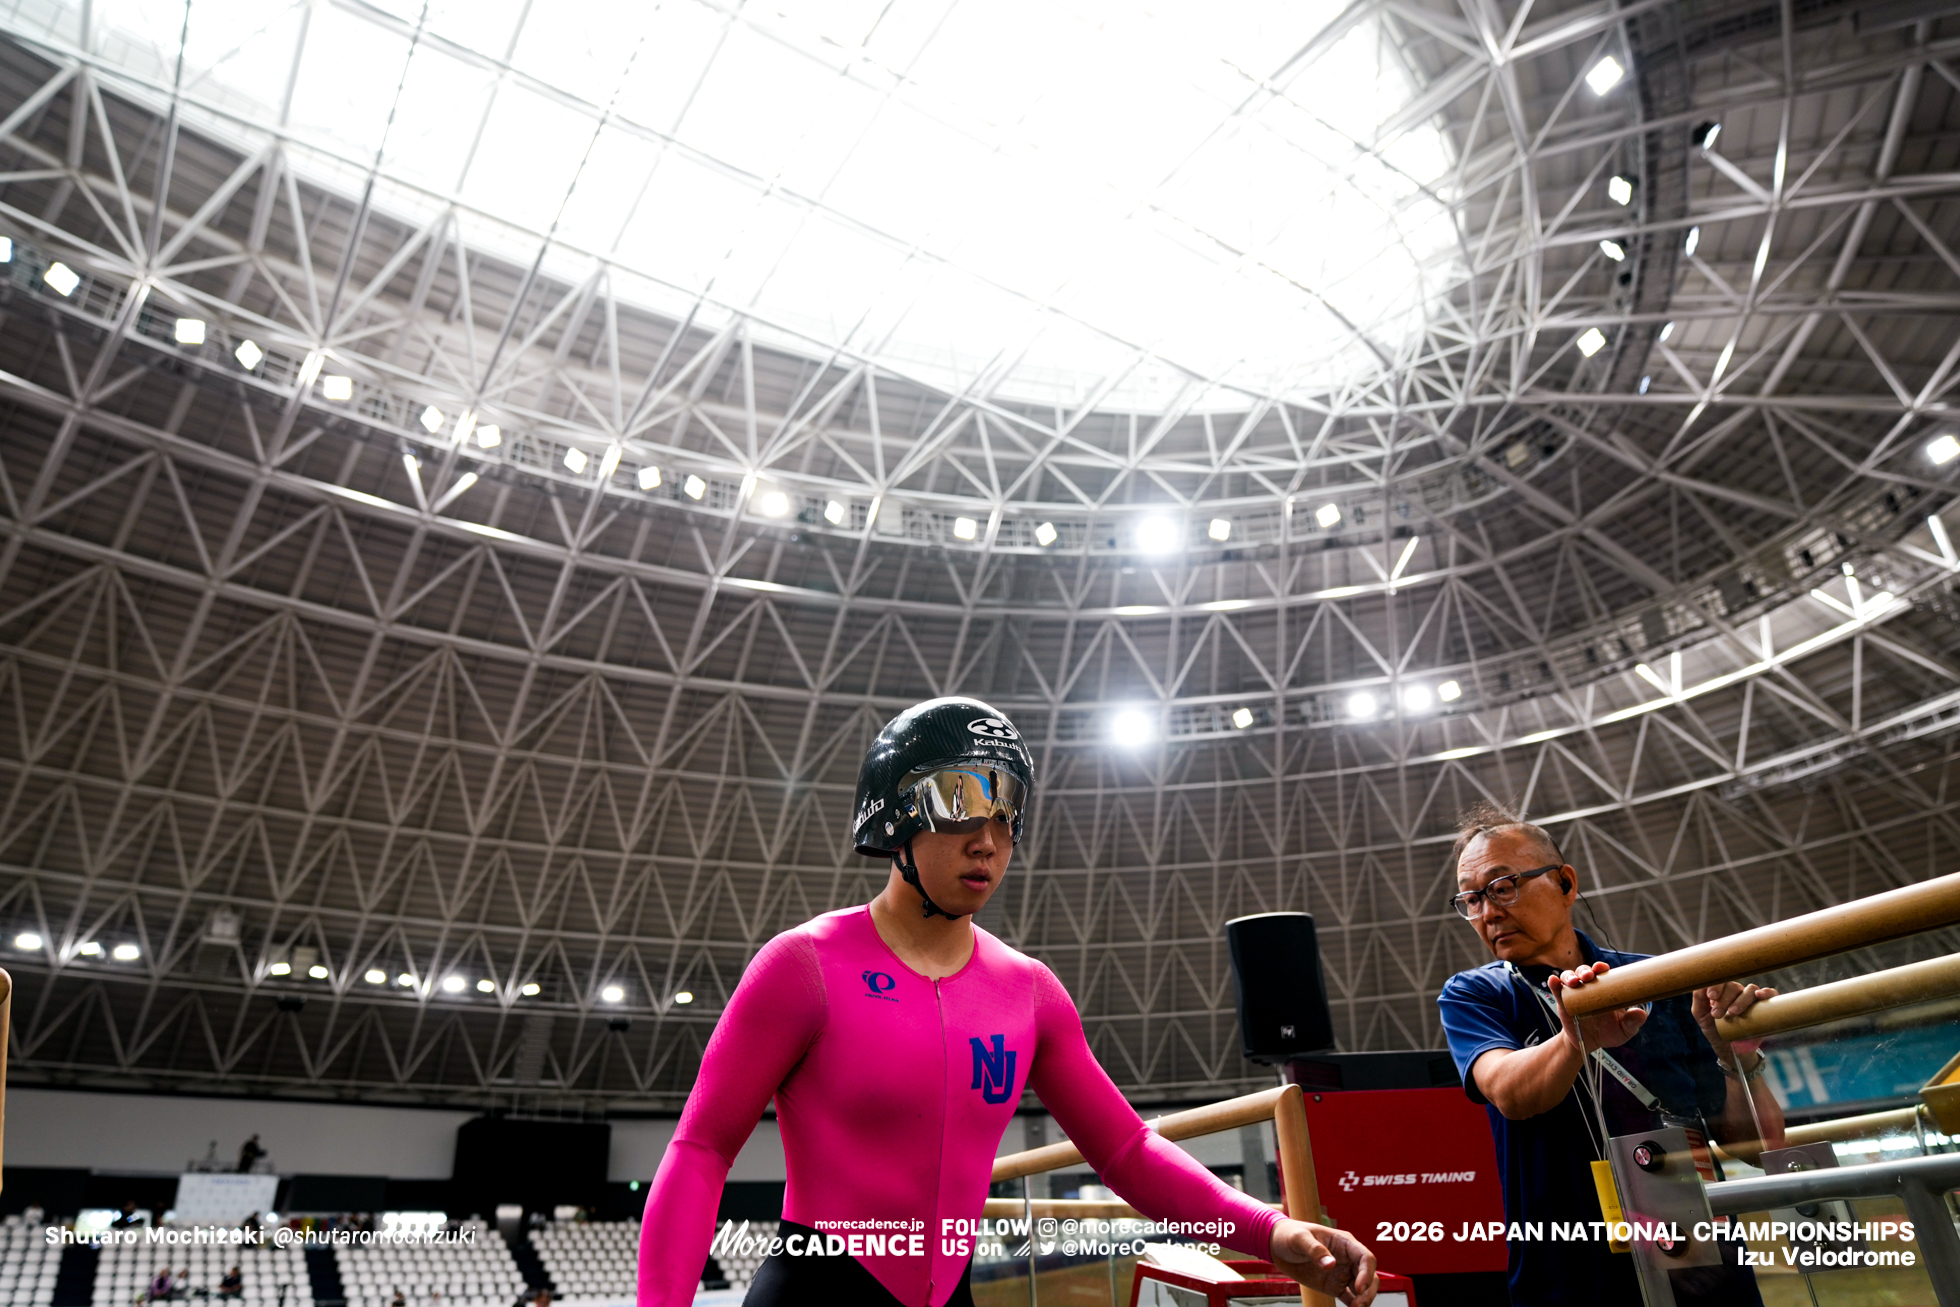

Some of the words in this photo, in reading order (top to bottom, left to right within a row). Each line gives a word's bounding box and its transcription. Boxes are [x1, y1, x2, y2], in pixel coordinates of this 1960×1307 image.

[973, 738, 1021, 752] Kabuto
[1362, 1173, 1417, 1186] SWISS
[1420, 1171, 1476, 1184] TIMING
